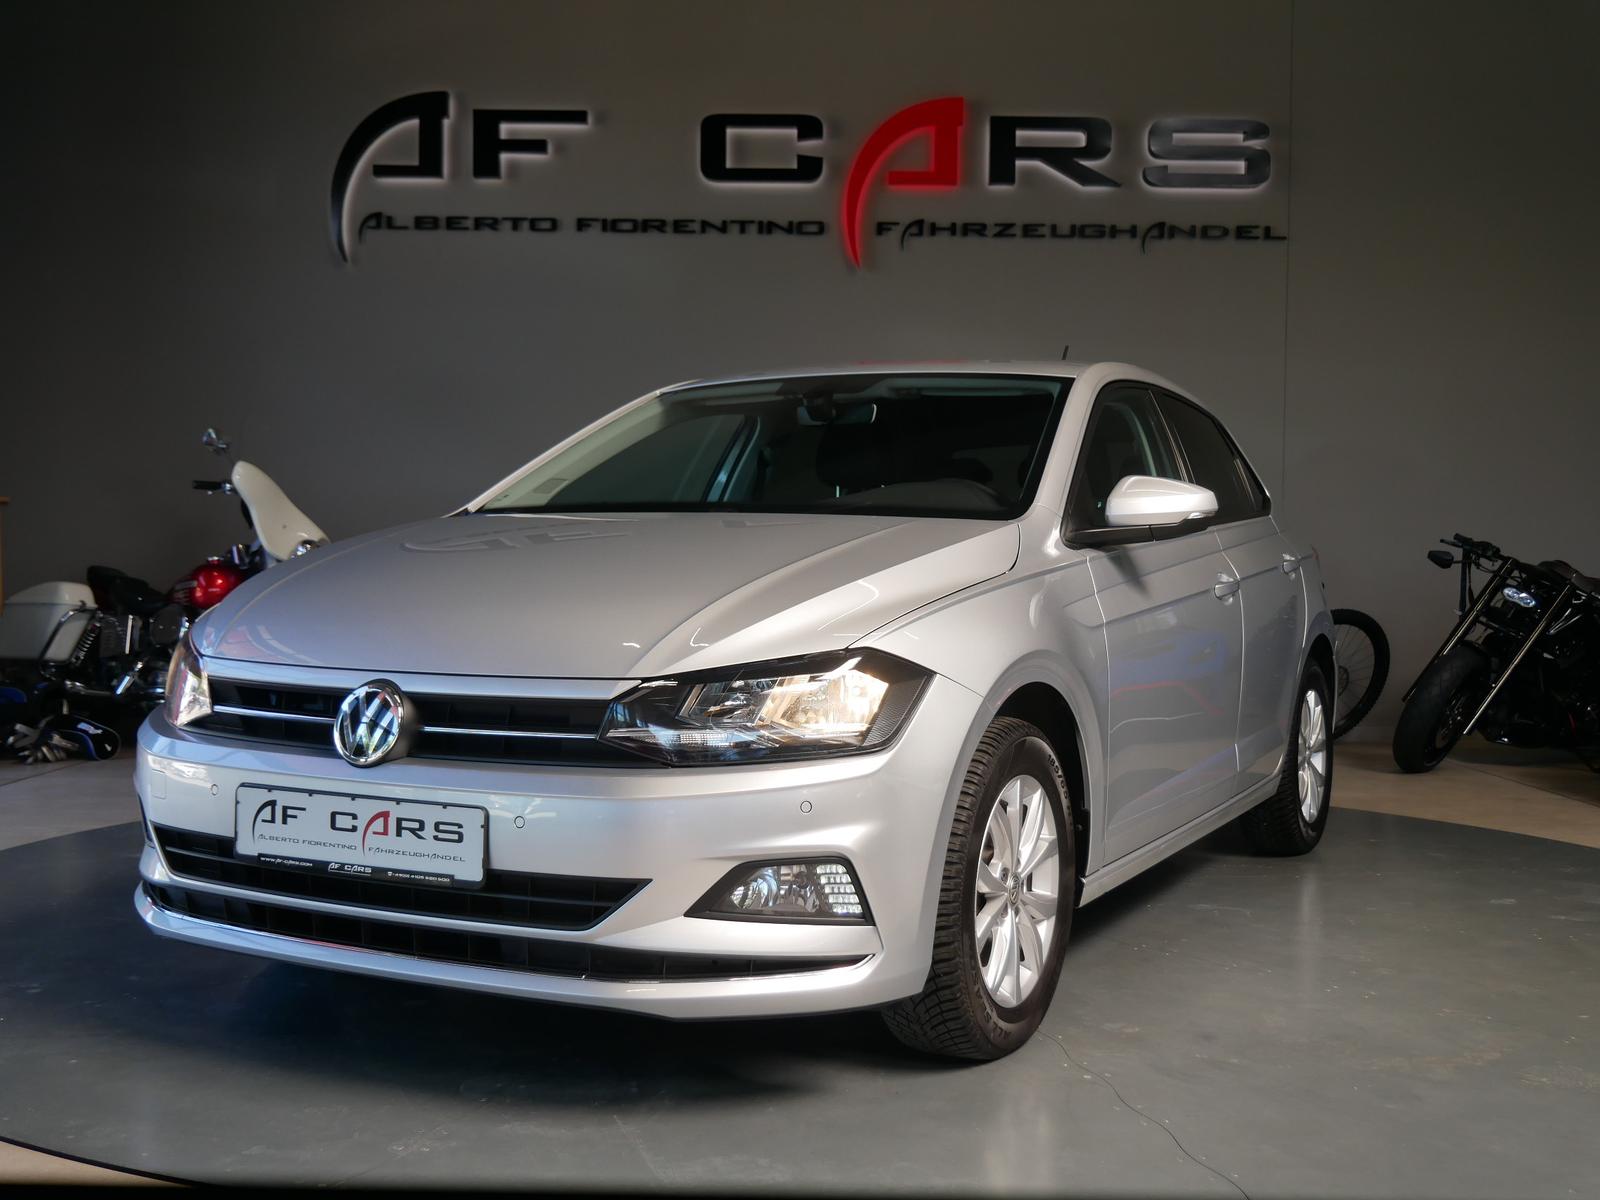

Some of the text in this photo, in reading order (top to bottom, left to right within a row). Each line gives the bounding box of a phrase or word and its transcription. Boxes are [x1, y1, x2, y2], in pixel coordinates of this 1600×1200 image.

[330, 91, 1272, 269] AF CARS
[359, 212, 1288, 255] ALBERTO FIORENTINO FAHRZEUGHANDEL
[252, 799, 464, 857] AF CARS
[258, 833, 466, 862] ALBERTO FIORENTINO FAHRZEUGHANDEL
[328, 862, 372, 874] AF CARS
